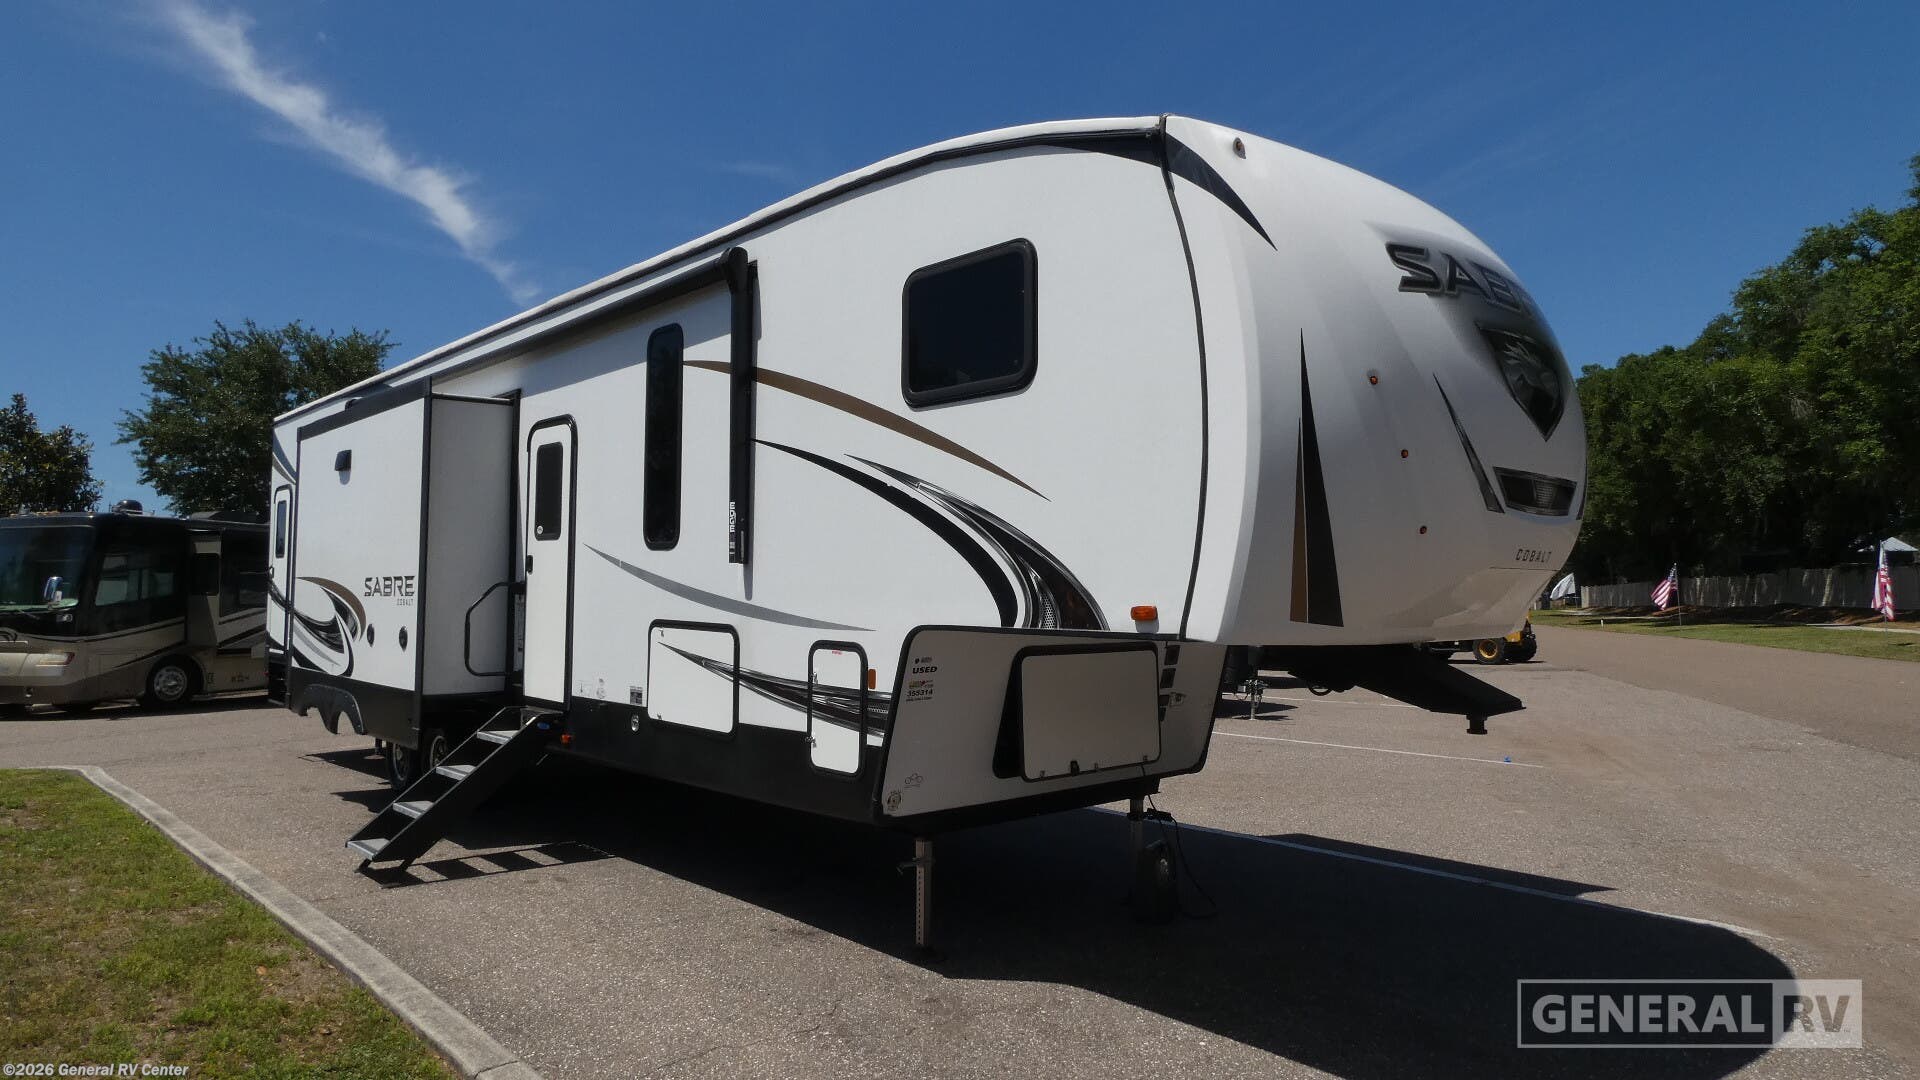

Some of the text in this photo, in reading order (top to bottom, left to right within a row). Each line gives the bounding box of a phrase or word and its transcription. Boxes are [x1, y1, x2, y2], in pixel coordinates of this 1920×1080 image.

[1515, 548, 1552, 563] COBALT
[364, 575, 415, 597] SABRE
[912, 666, 938, 674] USED
